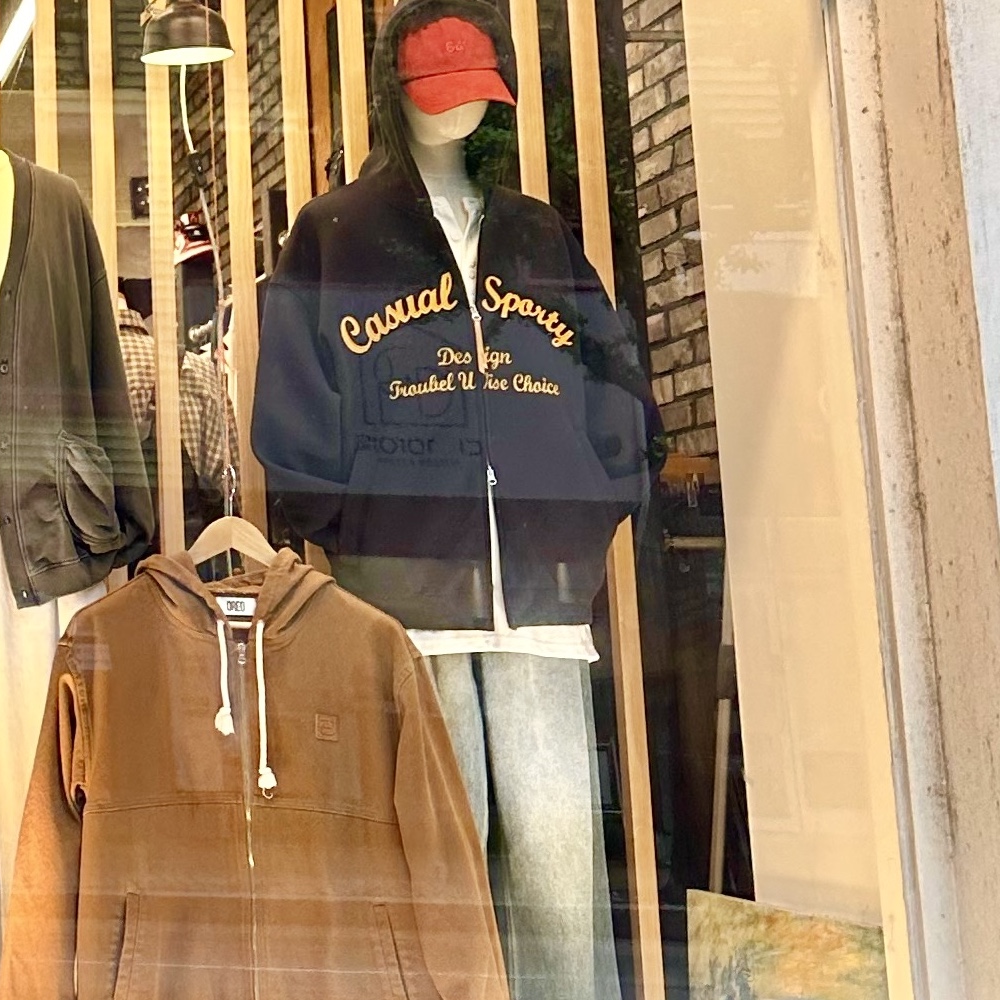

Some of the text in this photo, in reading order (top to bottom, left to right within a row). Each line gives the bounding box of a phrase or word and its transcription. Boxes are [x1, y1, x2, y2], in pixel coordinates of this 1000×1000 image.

[339, 271, 575, 354] Casual Sporty
[512, 373, 560, 396] Choice
